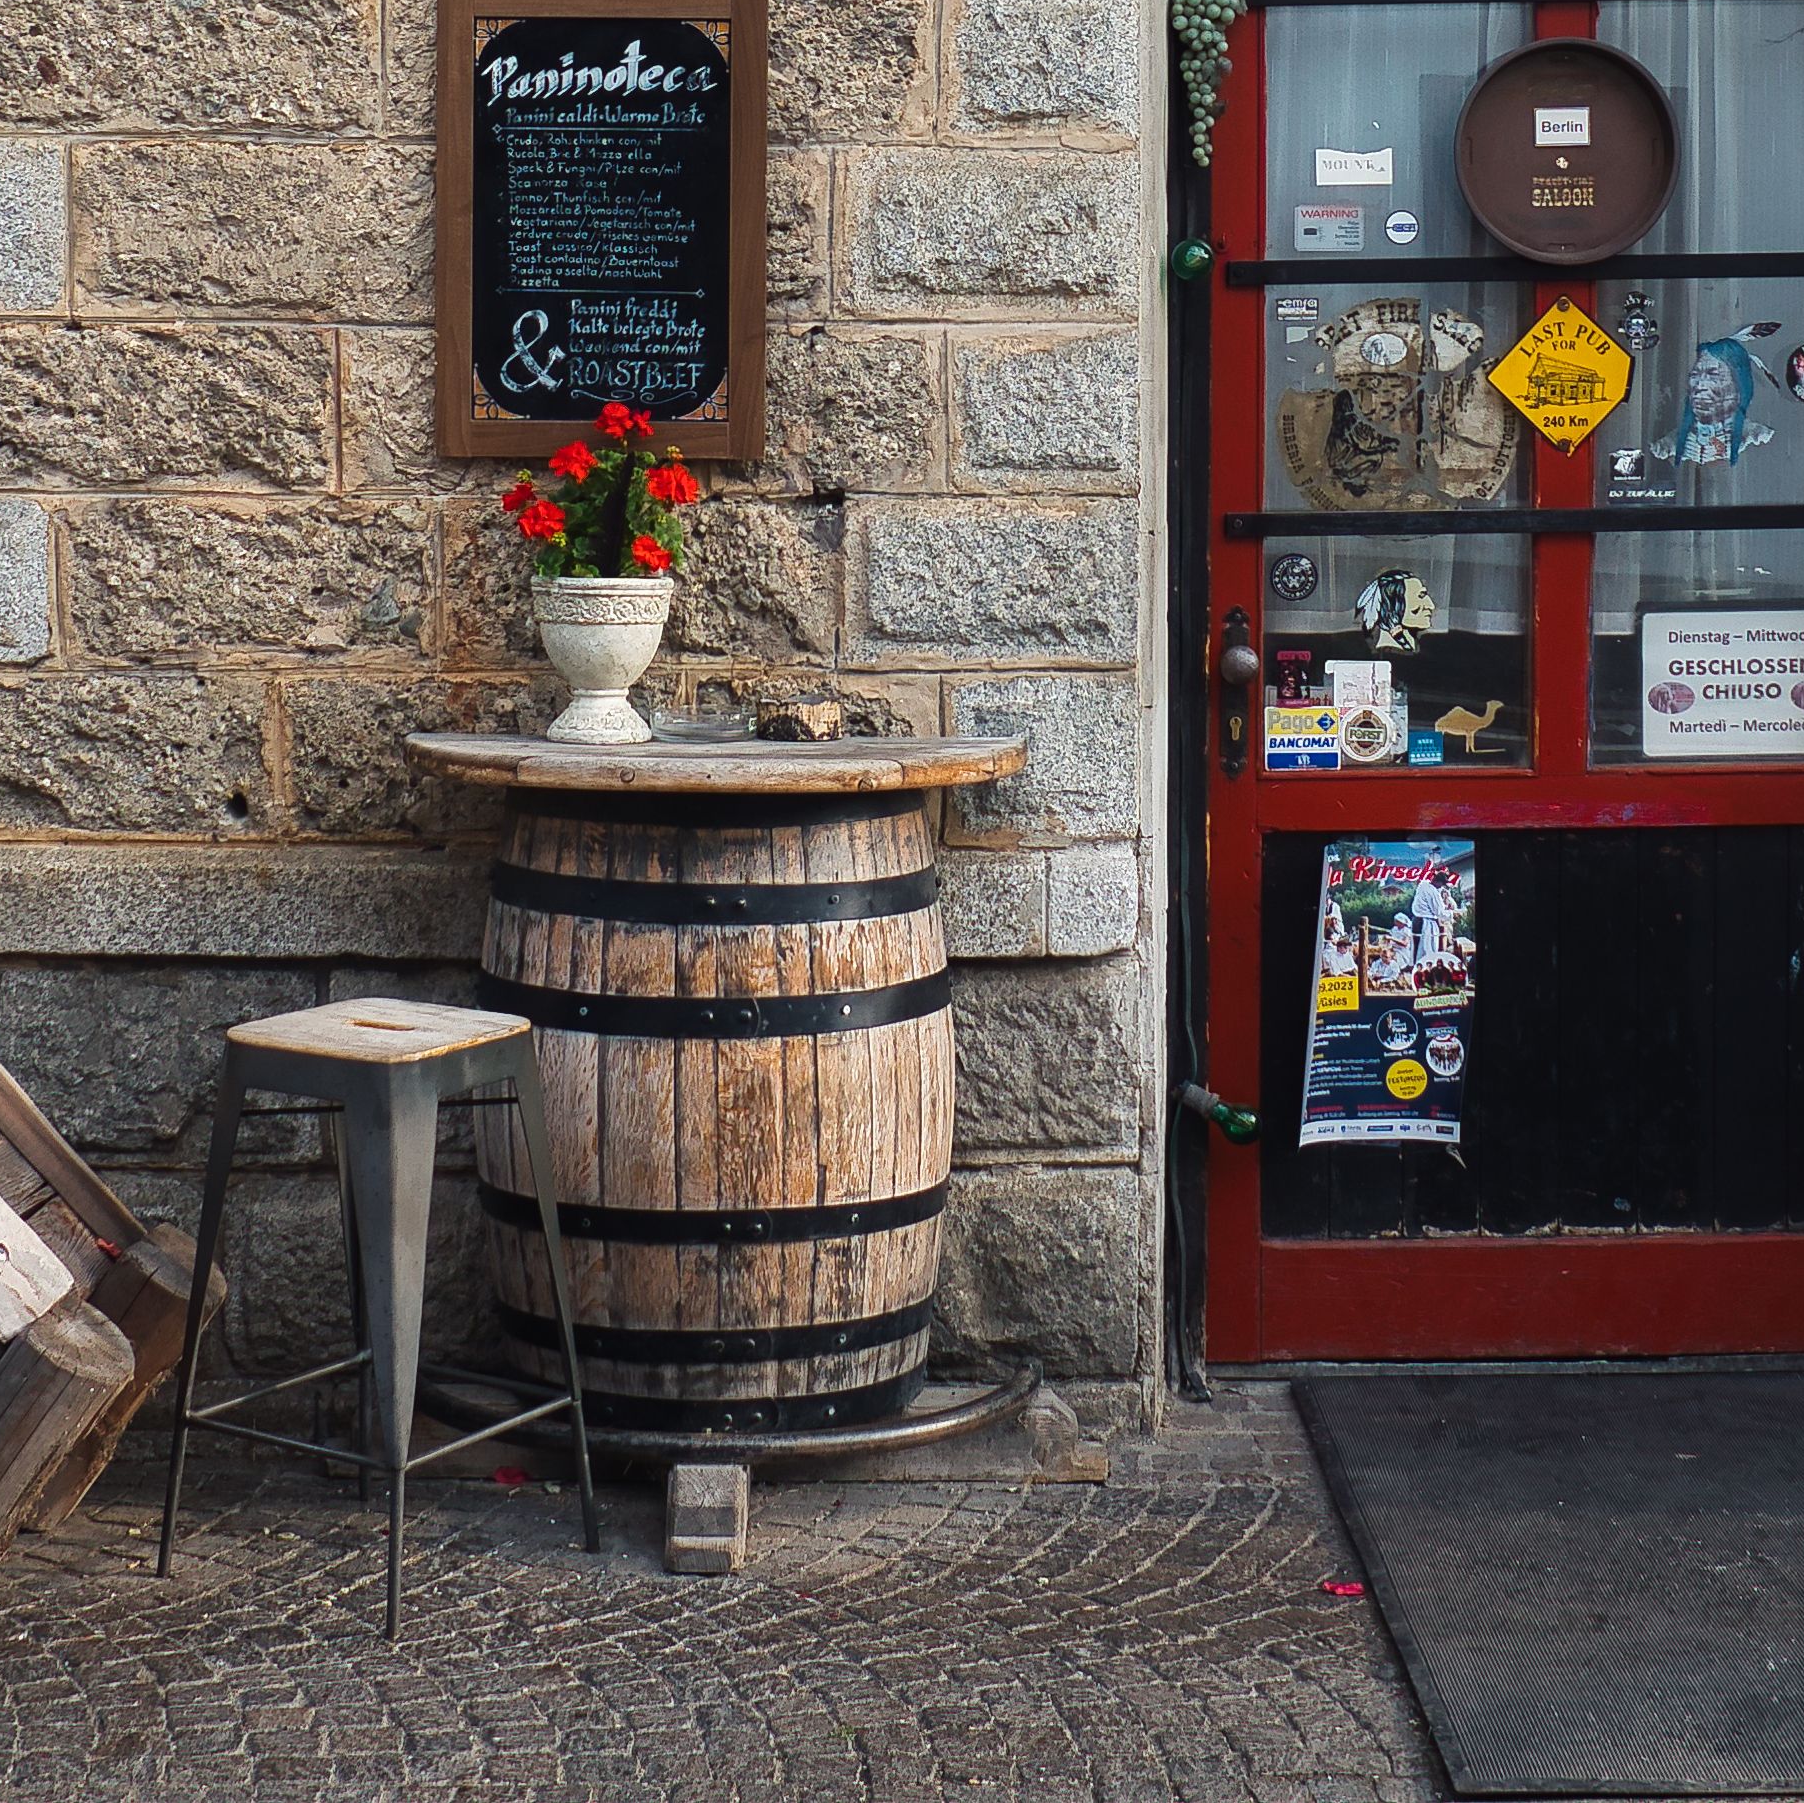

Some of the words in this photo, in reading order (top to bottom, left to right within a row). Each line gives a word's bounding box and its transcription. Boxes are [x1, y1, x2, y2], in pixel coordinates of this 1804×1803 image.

[481, 39, 718, 107] Paninoteca
[505, 106, 555, 124] Panini
[1541, 121, 1584, 133] Berlin
[508, 161, 544, 176] Speck
[1531, 187, 1595, 207] SALOON
[509, 204, 572, 215] Mozzarella
[574, 204, 582, 215] &
[1300, 209, 1359, 219] WARNING
[507, 241, 542, 253] Toast
[570, 298, 621, 318] Panini
[624, 296, 678, 319] freddi
[568, 317, 610, 336] Kalte
[664, 318, 707, 338] Brote
[1519, 322, 1566, 358] LAST
[1575, 324, 1612, 356] PUB
[1552, 340, 1577, 352] FOR
[499, 309, 567, 393] &
[1542, 416, 1566, 428] 240
[1568, 415, 1589, 427] Km
[1668, 630, 1730, 645] Dienstag
[1702, 682, 1782, 700] CHIUSO
[1268, 709, 1314, 733] Pago
[1669, 718, 1727, 734] Martedì
[1349, 729, 1383, 740] FORST
[1269, 736, 1338, 749] BANCOMAT
